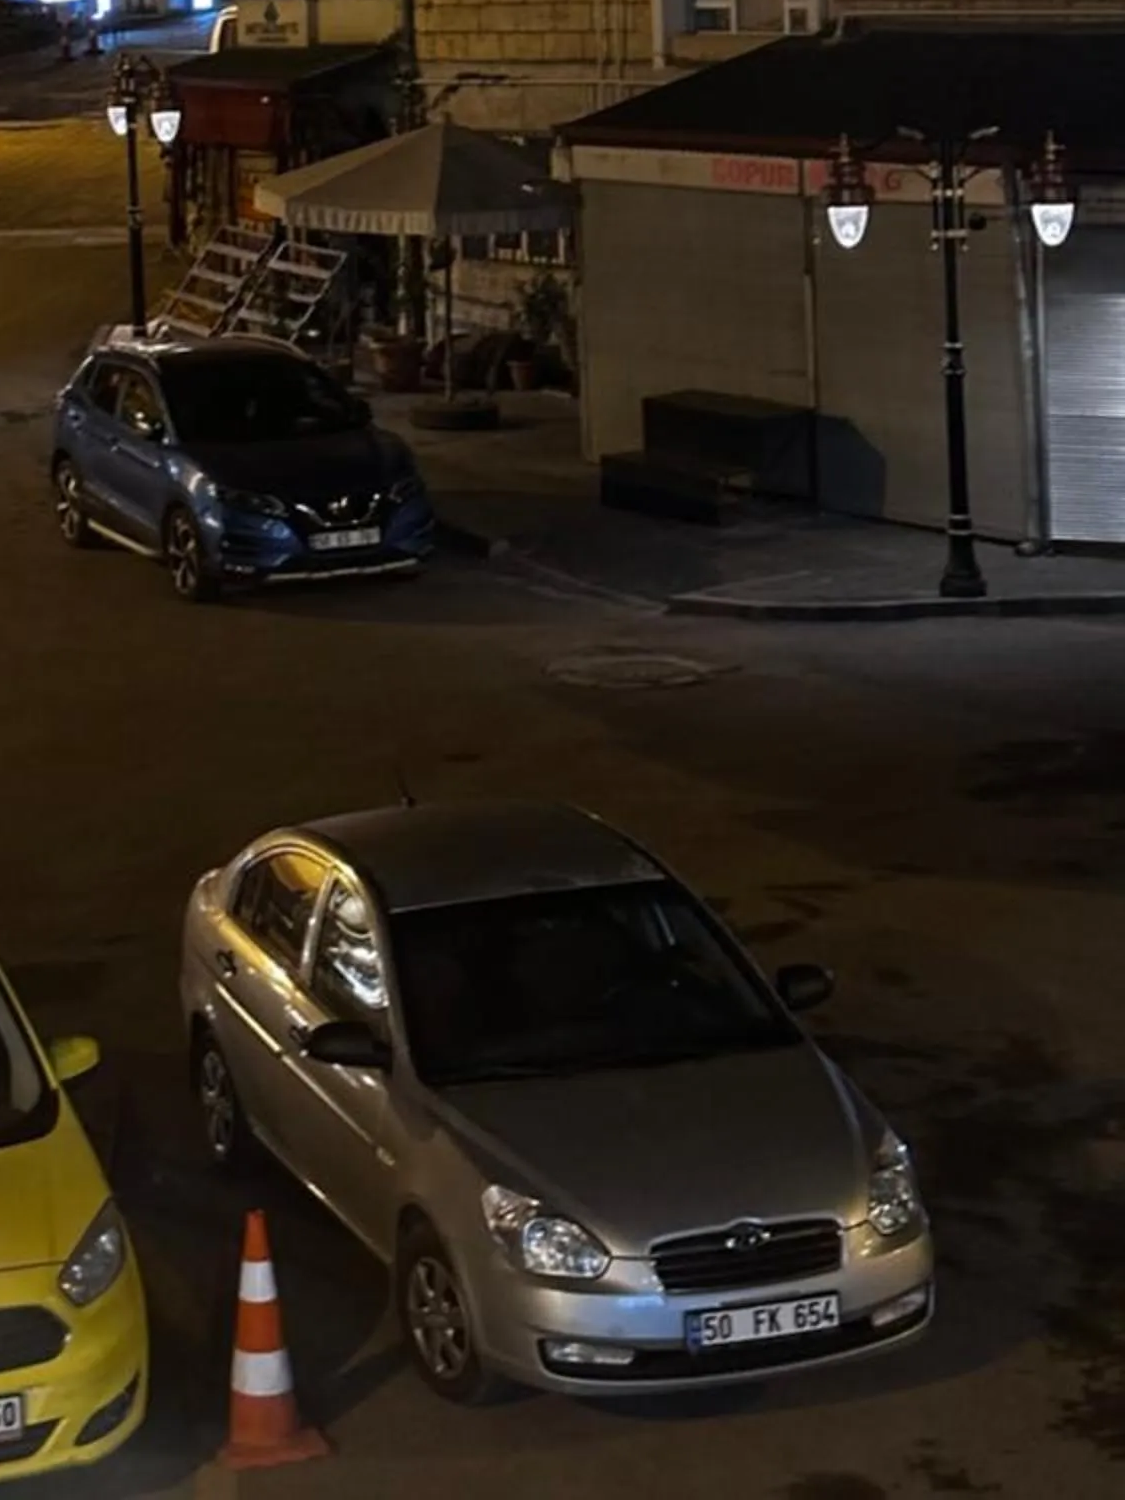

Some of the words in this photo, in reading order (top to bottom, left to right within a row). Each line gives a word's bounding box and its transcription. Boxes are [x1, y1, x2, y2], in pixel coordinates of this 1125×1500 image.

[702, 1314, 733, 1341] 50
[752, 1306, 782, 1336] FK
[793, 1300, 836, 1328] 654
